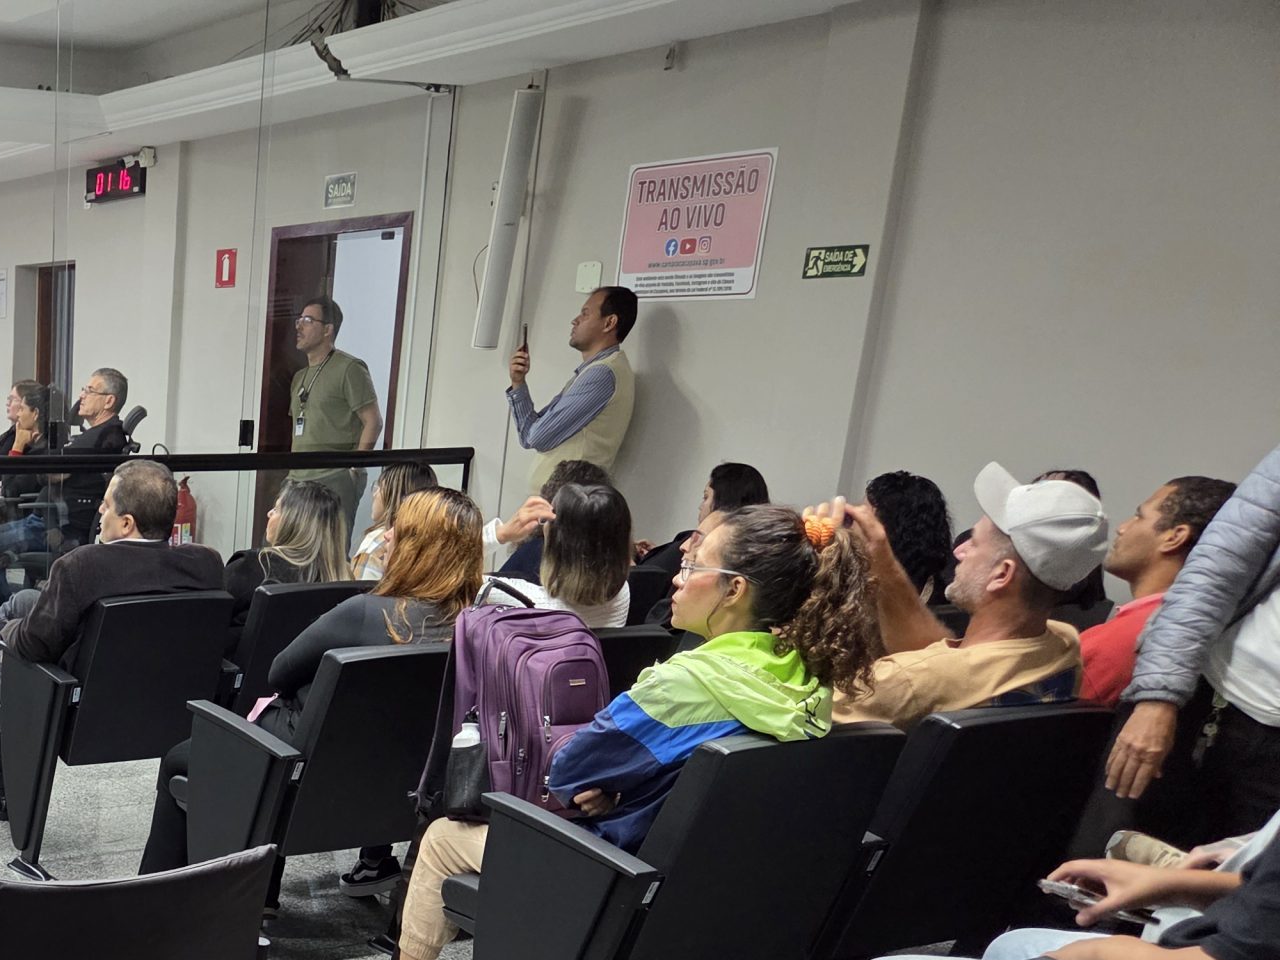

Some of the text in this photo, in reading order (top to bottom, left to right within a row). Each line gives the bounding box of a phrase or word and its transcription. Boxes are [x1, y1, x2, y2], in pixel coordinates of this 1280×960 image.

[638, 165, 760, 204] TRANSMISSÃO
[657, 202, 726, 231] AO VIVO
[825, 248, 854, 263] SAÍDA DE
